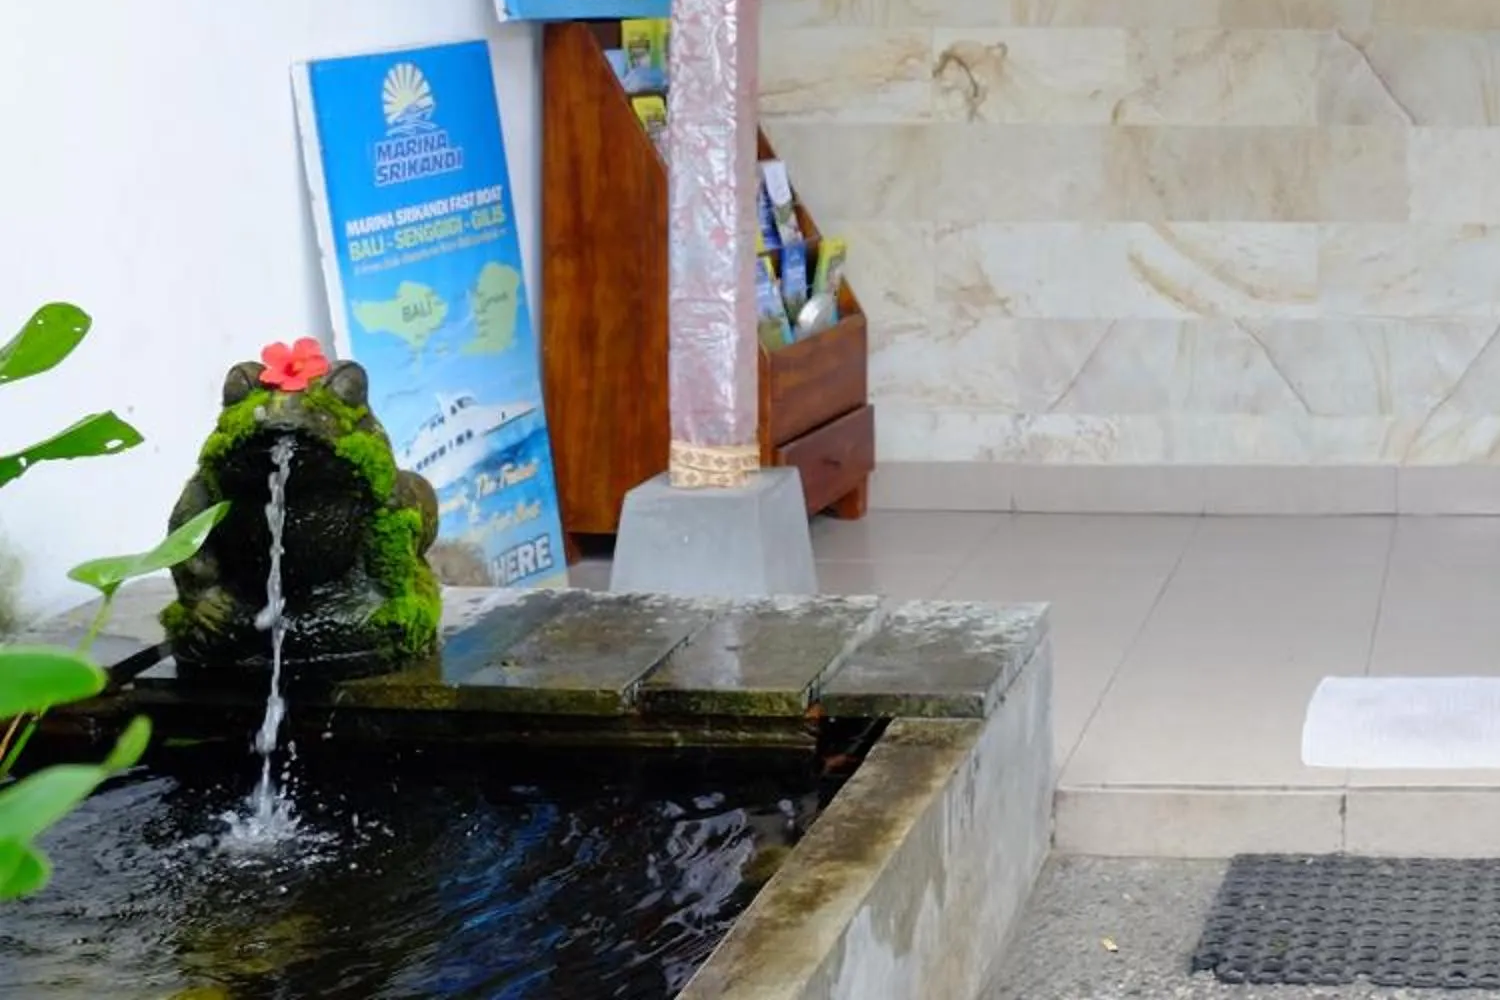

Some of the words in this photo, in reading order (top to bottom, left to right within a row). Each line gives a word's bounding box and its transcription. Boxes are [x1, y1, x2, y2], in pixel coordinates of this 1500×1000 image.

[377, 133, 447, 162] MARINA
[376, 150, 462, 185] SRIKANDI
[401, 297, 433, 322] BALI
[492, 535, 552, 586] HERE
